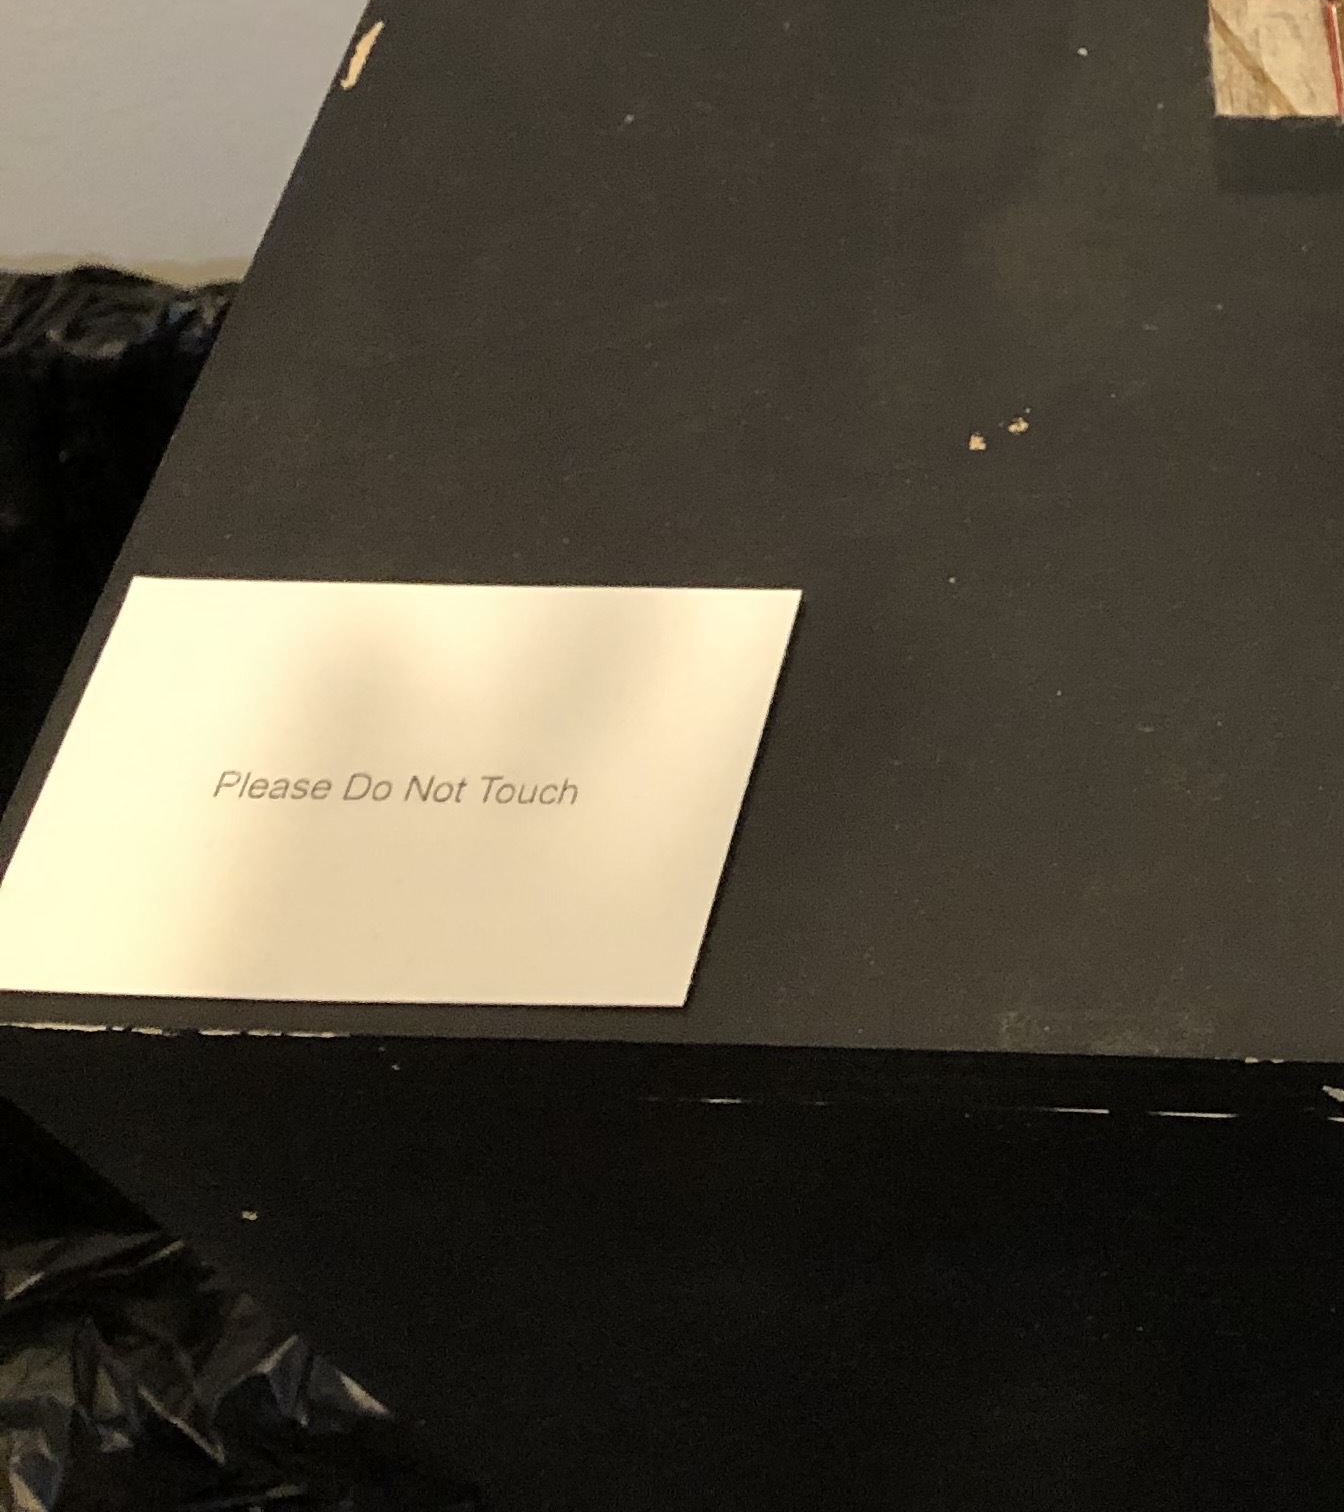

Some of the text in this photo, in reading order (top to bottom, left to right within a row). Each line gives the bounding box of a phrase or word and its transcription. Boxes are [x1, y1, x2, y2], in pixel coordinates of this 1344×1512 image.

[213, 770, 579, 806] Please Do Not Touch
